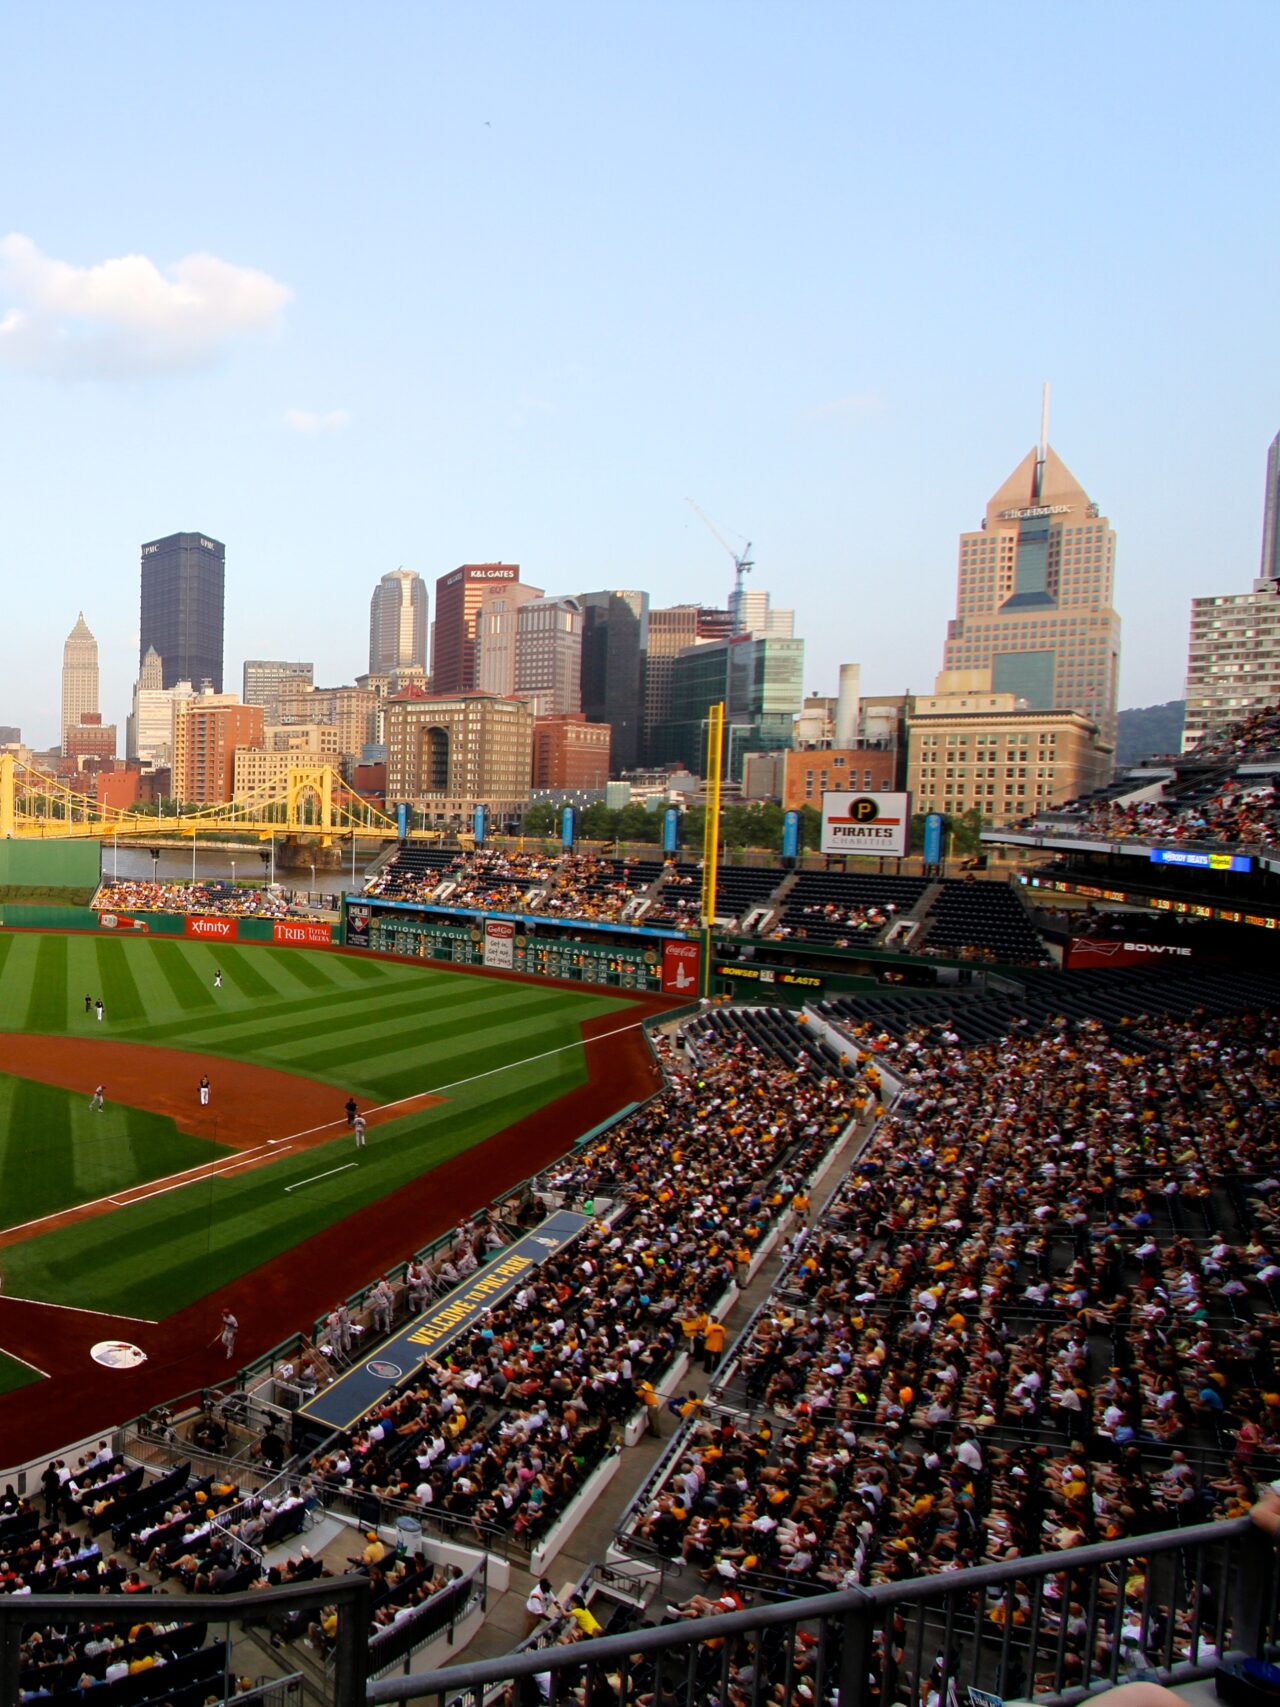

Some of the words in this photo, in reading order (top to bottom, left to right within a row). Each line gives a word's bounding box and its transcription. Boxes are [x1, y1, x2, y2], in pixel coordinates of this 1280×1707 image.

[471, 570, 487, 578] K&L
[487, 570, 514, 578] GATES
[858, 803, 872, 819] P
[833, 827, 893, 838] PIRATES
[832, 837, 893, 846] CHARITIES
[350, 906, 368, 916] MLB
[192, 919, 230, 936] xfinity
[274, 924, 306, 940] TRIB
[380, 924, 428, 935] NATIONAL
[431, 930, 469, 940] LEAGUE
[487, 925, 512, 935] GetGo
[528, 943, 589, 956] AMERICAN
[593, 951, 642, 963] LEAGUE
[665, 944, 697, 958] Coca-Cola
[1123, 942, 1192, 956] BOWTIE
[722, 967, 759, 978] BOWSER
[784, 975, 821, 986] BLASTS
[494, 1254, 533, 1281] PARK
[474, 1271, 510, 1294] PNC
[464, 1289, 487, 1302] TO
[406, 1299, 477, 1346] WELCOME
